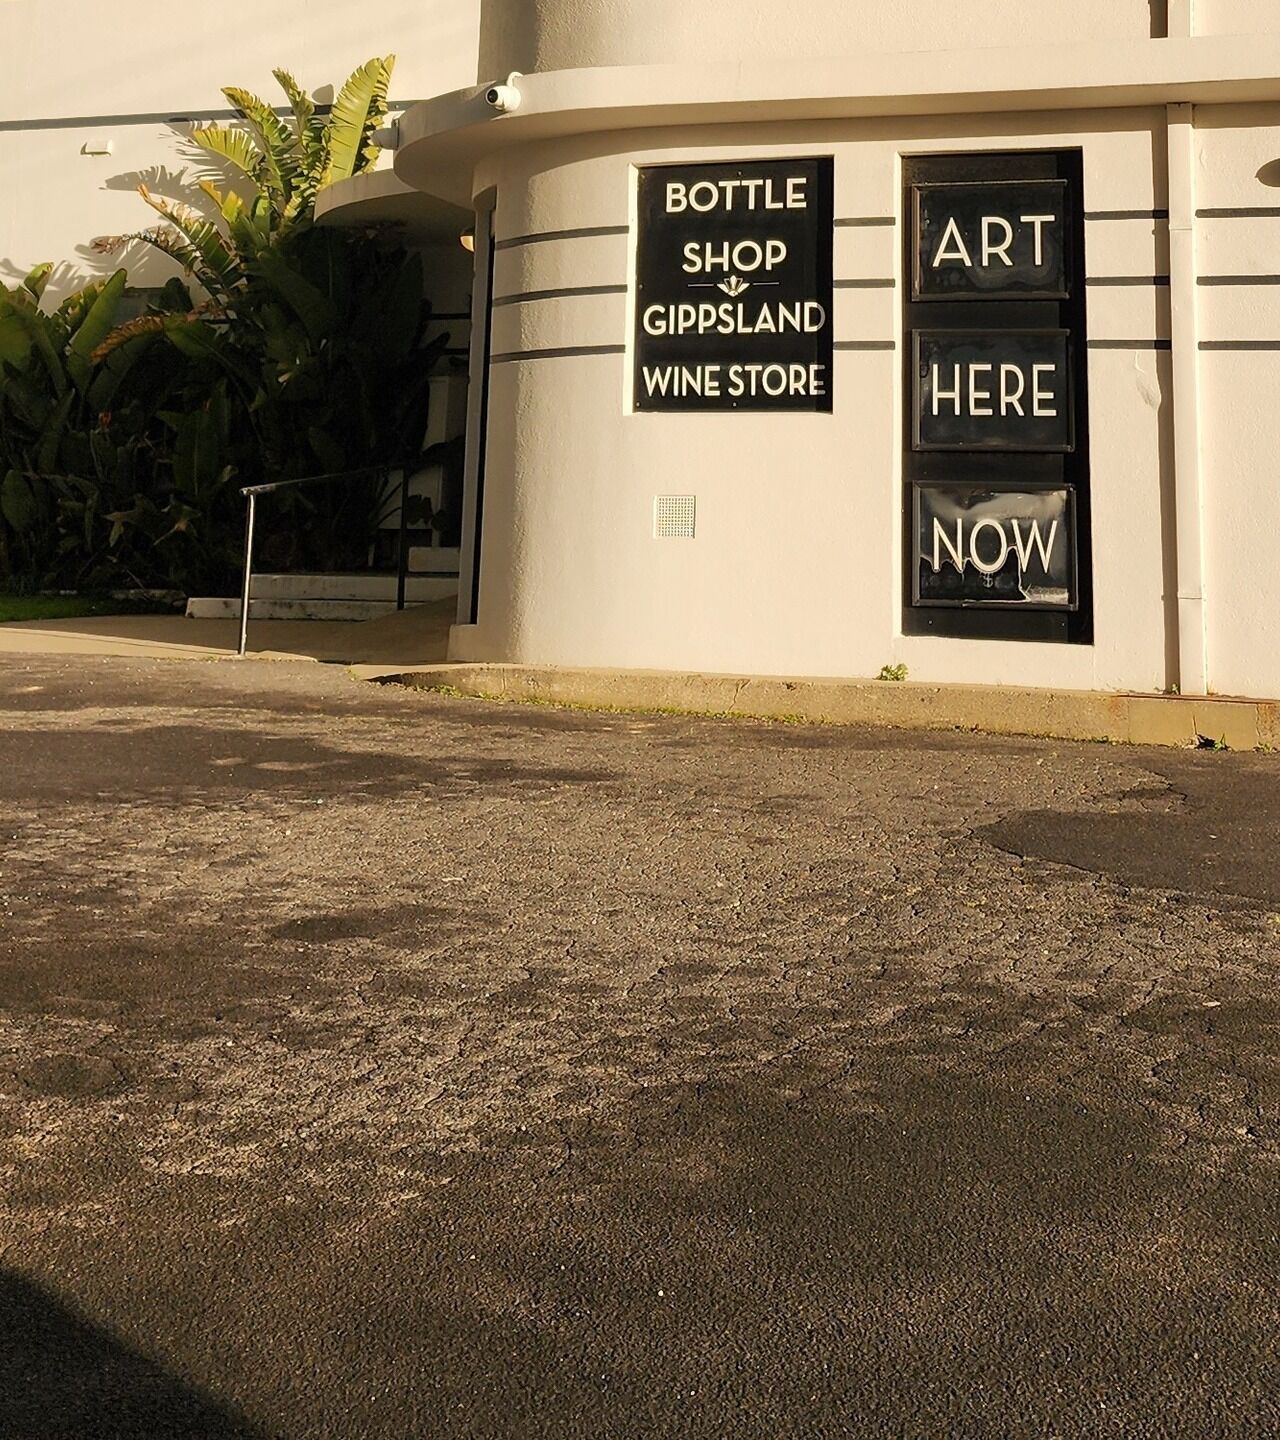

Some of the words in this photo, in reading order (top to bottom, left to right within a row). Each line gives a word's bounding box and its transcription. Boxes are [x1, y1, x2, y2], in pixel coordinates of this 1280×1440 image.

[665, 177, 807, 213] BOTTLE
[681, 239, 787, 273] SHOP
[933, 214, 1055, 268] ART
[642, 301, 826, 336] GIPPSLAND
[642, 365, 721, 397] WINE
[727, 363, 826, 397] STORE
[932, 363, 1057, 417] HERE
[933, 517, 1058, 573] NOW
